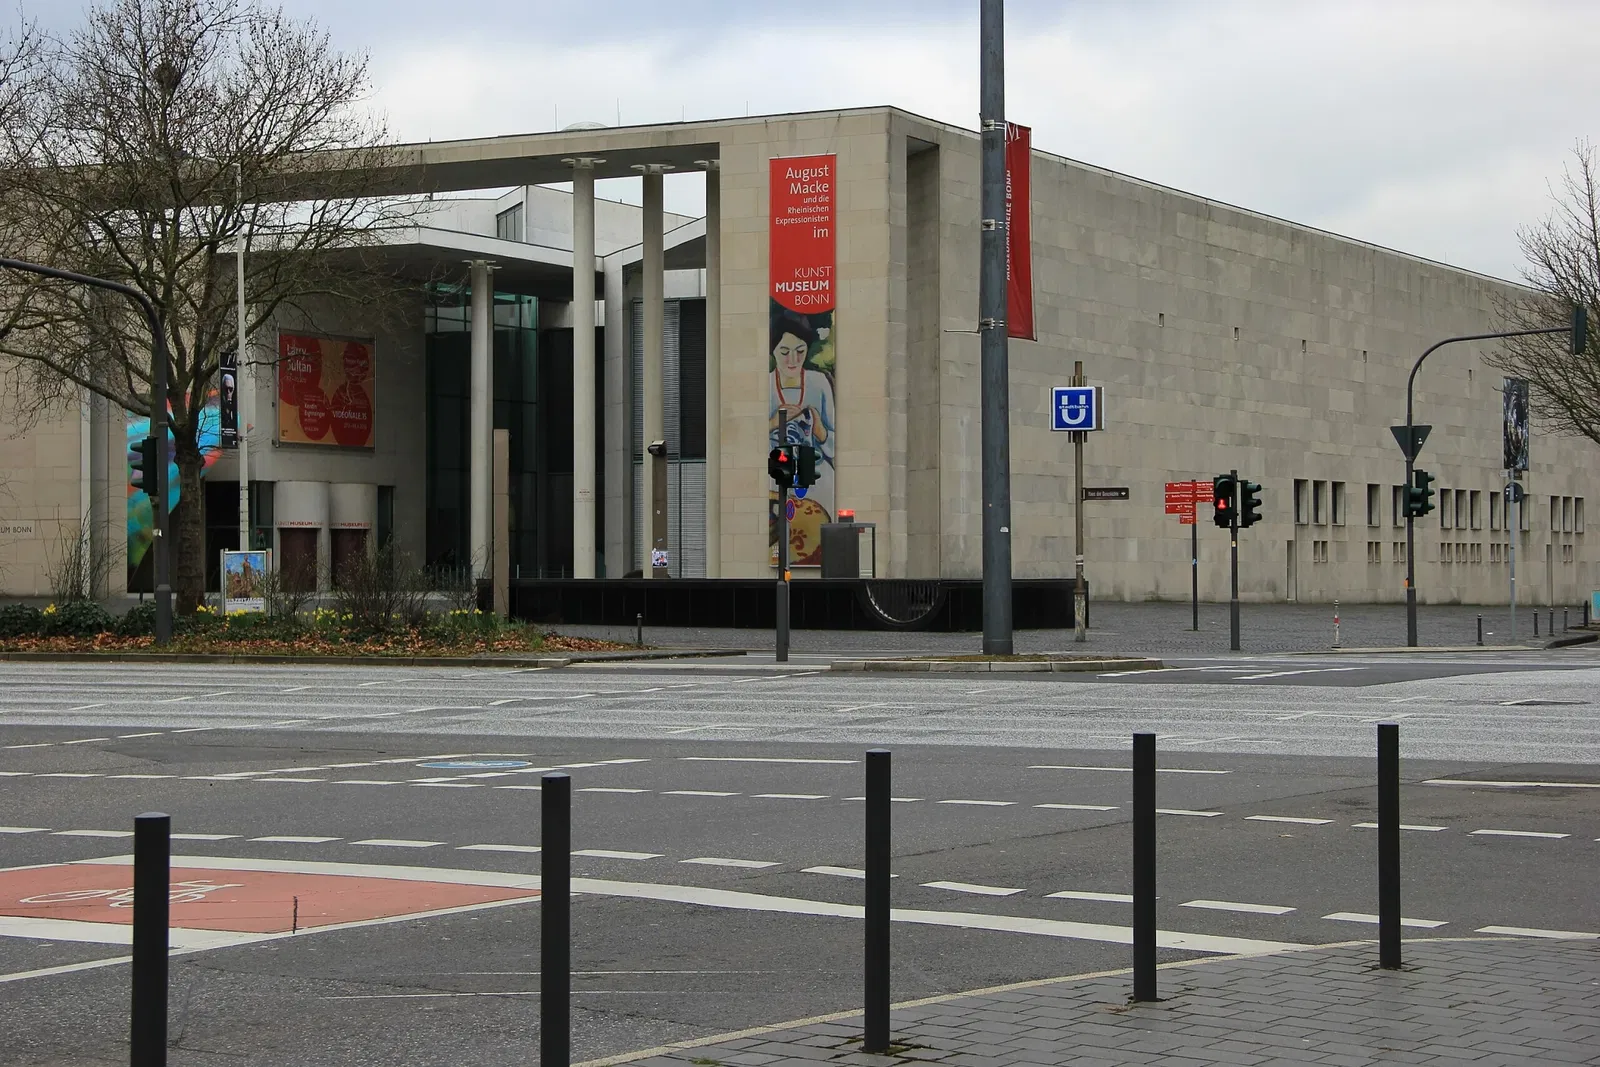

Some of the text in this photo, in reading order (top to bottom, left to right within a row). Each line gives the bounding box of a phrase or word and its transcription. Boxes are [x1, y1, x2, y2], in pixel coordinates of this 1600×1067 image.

[785, 165, 829, 181] August
[790, 181, 829, 195] Macke
[803, 194, 829, 204] und die
[787, 205, 829, 215] Rheinischen
[775, 214, 829, 226] Expressionisten
[813, 226, 829, 239] im
[794, 265, 832, 279] KUNST
[775, 279, 829, 293] MUSEUM
[794, 294, 830, 306] BONN
[286, 344, 307, 361] Larry
[287, 359, 312, 374] Sultan
